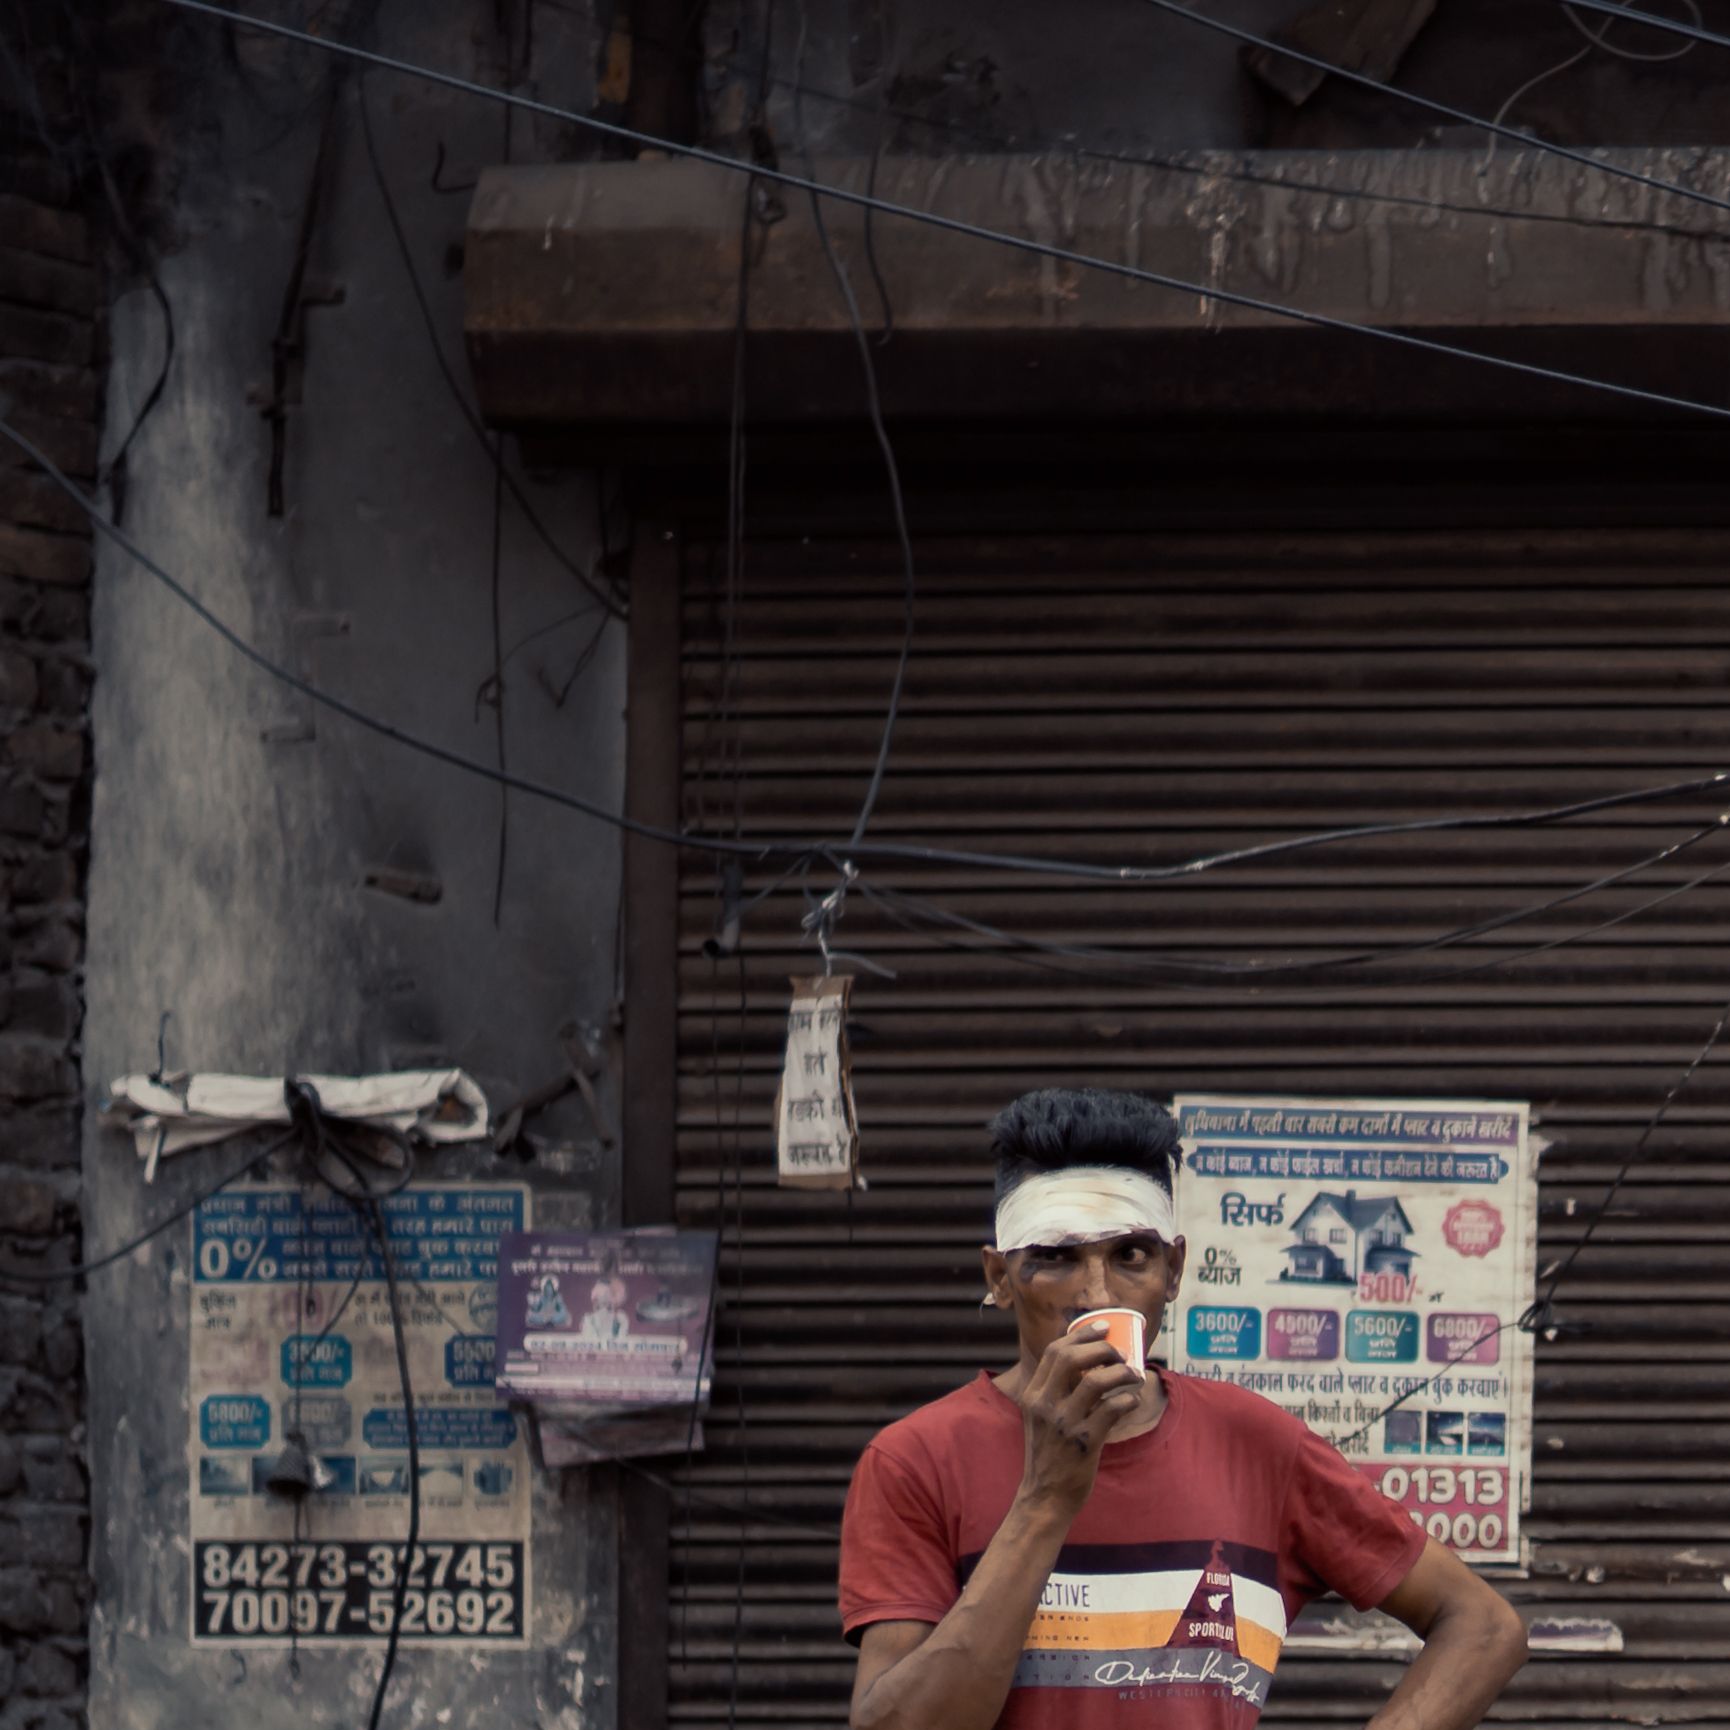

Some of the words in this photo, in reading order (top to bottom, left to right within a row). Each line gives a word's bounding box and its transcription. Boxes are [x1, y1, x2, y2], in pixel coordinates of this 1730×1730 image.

[1220, 1192, 1286, 1227] सिर्फ
[200, 1237, 278, 1280] 0%
[1204, 1247, 1237, 1266] 0%
[1198, 1265, 1242, 1286] ब्याज
[1359, 1273, 1424, 1304] 500/-
[1195, 1312, 1254, 1333] 3600/-
[1353, 1316, 1412, 1337] 5600/-
[1318, 1367, 1344, 1393] वाले
[1432, 1376, 1453, 1403] बुक
[1377, 1466, 1505, 1505] 01313
[203, 1545, 515, 1588] 84273-32745
[203, 1591, 515, 1634] 70097-52692
